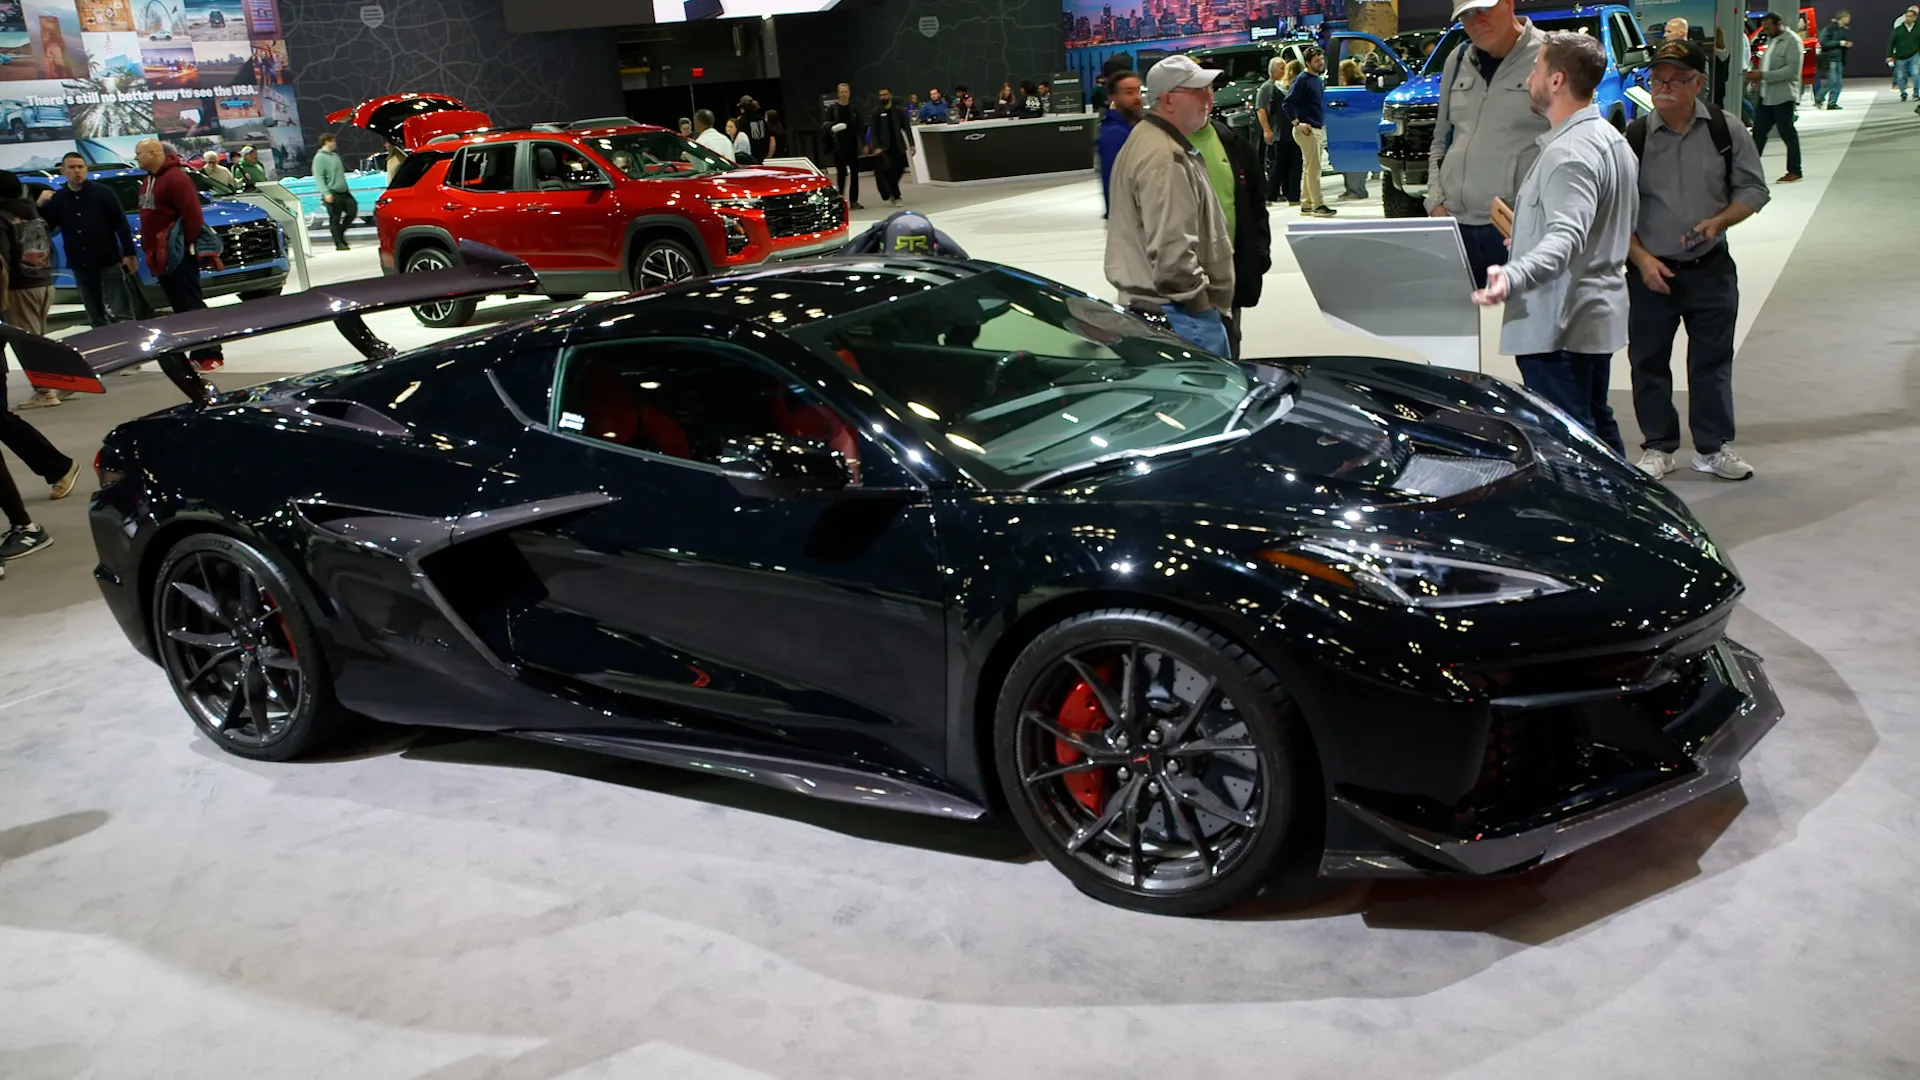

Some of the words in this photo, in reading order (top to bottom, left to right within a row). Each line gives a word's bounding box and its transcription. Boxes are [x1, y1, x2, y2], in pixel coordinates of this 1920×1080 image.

[26, 94, 74, 106] There's
[75, 92, 100, 104] still
[101, 93, 116, 102] no
[117, 90, 154, 102] better
[156, 90, 179, 101] way
[180, 88, 192, 98] to
[193, 88, 213, 98] see
[213, 85, 231, 96] the
[233, 84, 259, 96] USA.
